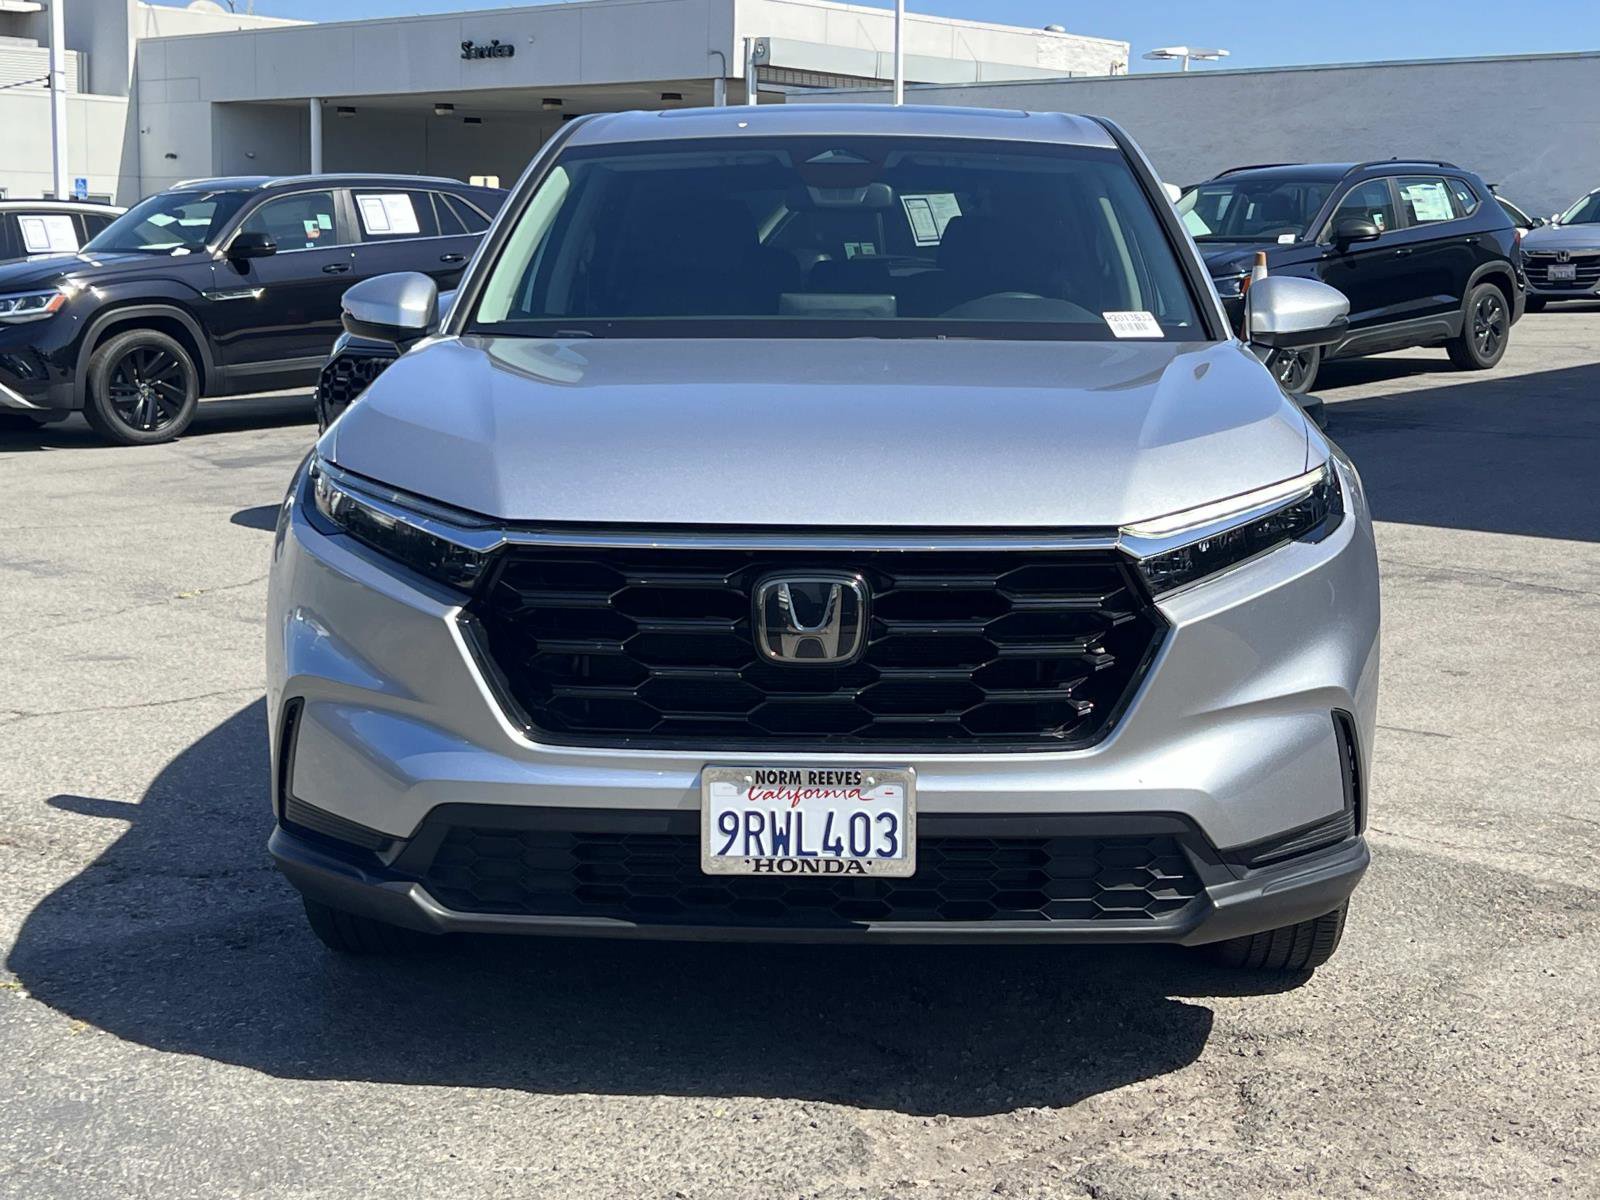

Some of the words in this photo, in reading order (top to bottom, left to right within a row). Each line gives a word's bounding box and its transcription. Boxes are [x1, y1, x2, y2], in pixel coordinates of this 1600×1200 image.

[755, 770, 802, 786] NORM
[808, 770, 862, 786] REEVES
[747, 785, 875, 808] California
[717, 810, 898, 858] 9RWL403
[752, 858, 868, 875] HONDA
